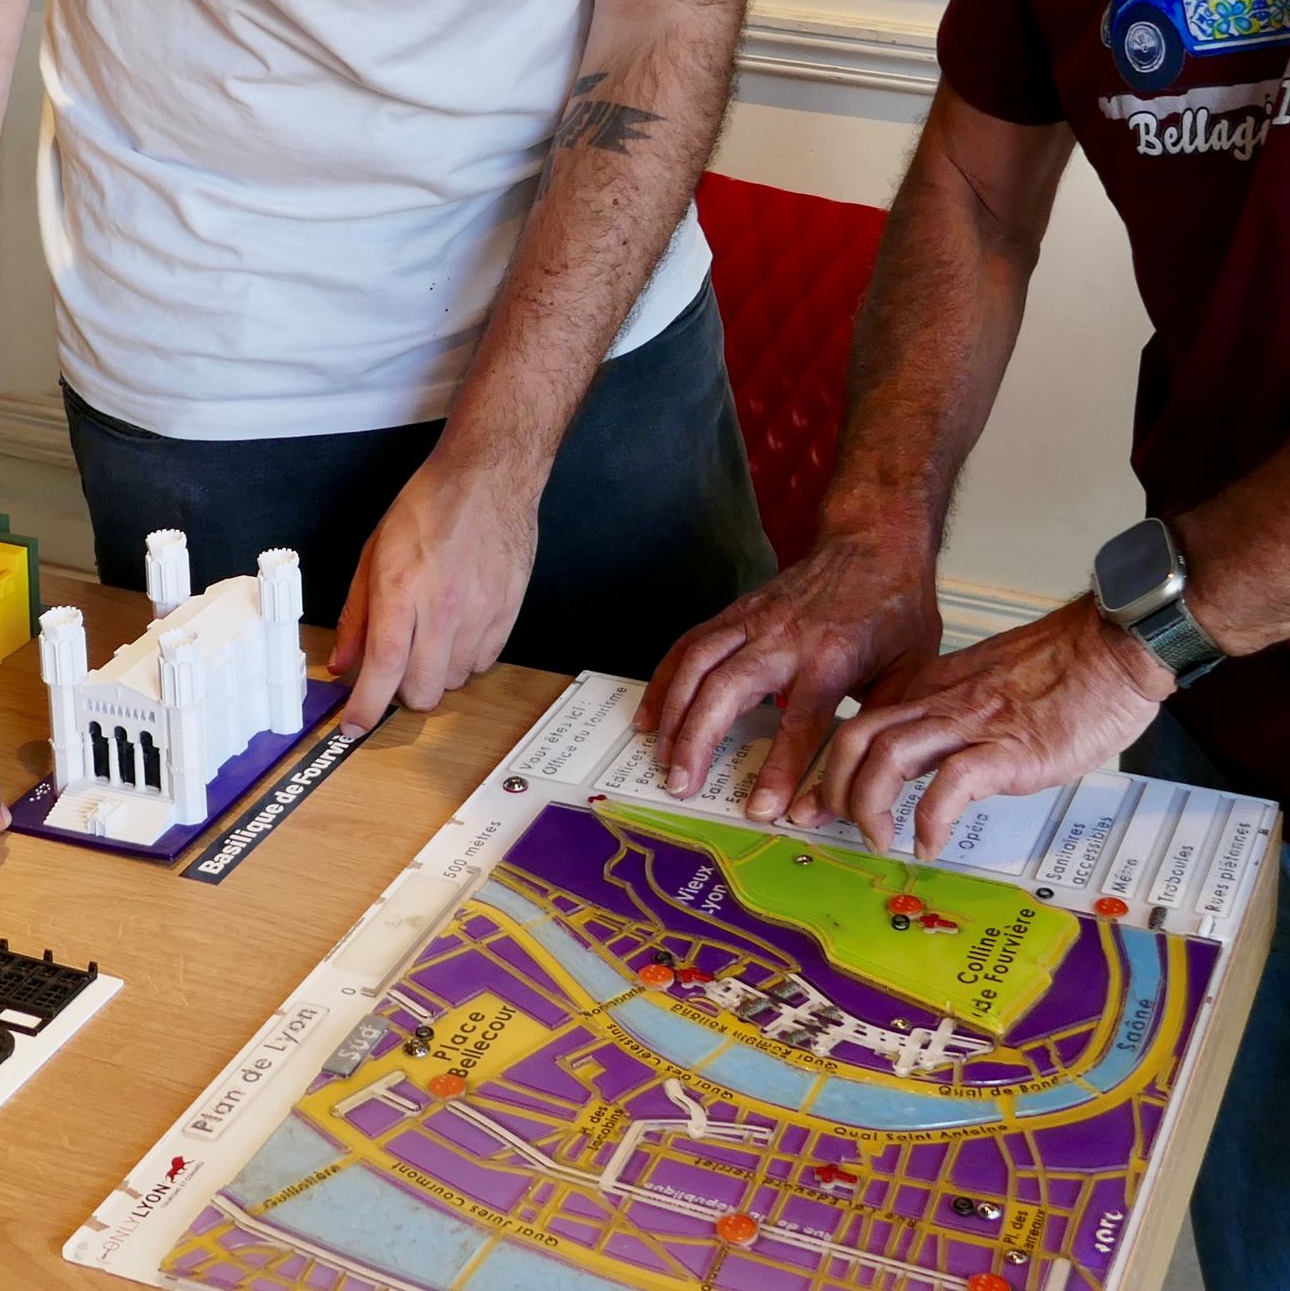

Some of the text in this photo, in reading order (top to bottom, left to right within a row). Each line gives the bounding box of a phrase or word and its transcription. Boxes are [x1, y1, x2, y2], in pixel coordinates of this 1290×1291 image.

[1128, 98, 1270, 160] Bellagi
[518, 742, 549, 771] Vous
[542, 745, 578, 776] Office
[573, 728, 591, 747] du
[197, 734, 357, 876] Basilique de Fourviè
[958, 812, 989, 851] Opéra
[442, 820, 502, 879] 500 mètres
[1072, 815, 1114, 885] accessibles
[1157, 844, 1195, 903] Traboules
[676, 865, 715, 906] Vieux
[956, 926, 1002, 985] Colline
[983, 907, 1037, 984] Fourvière
[338, 1021, 382, 1062] Sud
[432, 1010, 487, 1062] Place
[446, 1003, 518, 1079] Bellecour
[1116, 997, 1155, 1052] Saône
[190, 1007, 319, 1134] Plan de Lyon
[990, 1087, 1014, 1097] de
[590, 1106, 609, 1125] des
[833, 1122, 1009, 1143] Quai Saint Antoine
[391, 1161, 560, 1248] Quai Jules Courmont
[1014, 1209, 1029, 1229] des
[1024, 1207, 1046, 1254] erreaux
